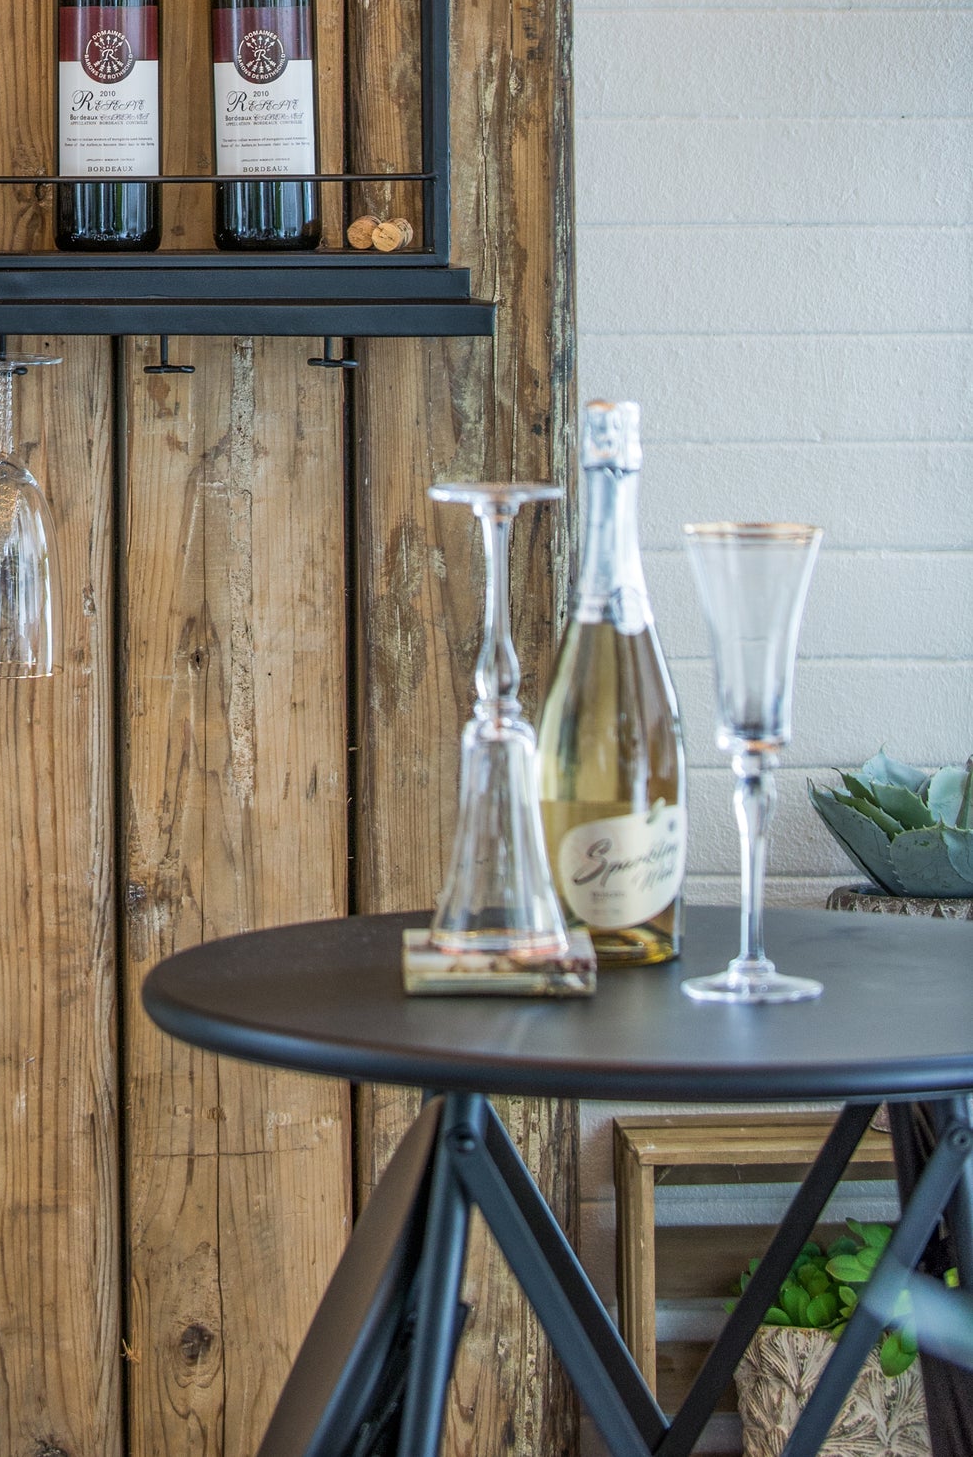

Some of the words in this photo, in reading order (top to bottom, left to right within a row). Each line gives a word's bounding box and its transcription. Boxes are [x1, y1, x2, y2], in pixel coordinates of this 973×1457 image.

[92, 29, 126, 40] DOMAINES
[244, 29, 278, 40] DOMAINES
[84, 54, 99, 76] BARONS
[107, 53, 134, 80] ROTHSCHILD
[259, 53, 286, 80] ROTHSCHILD
